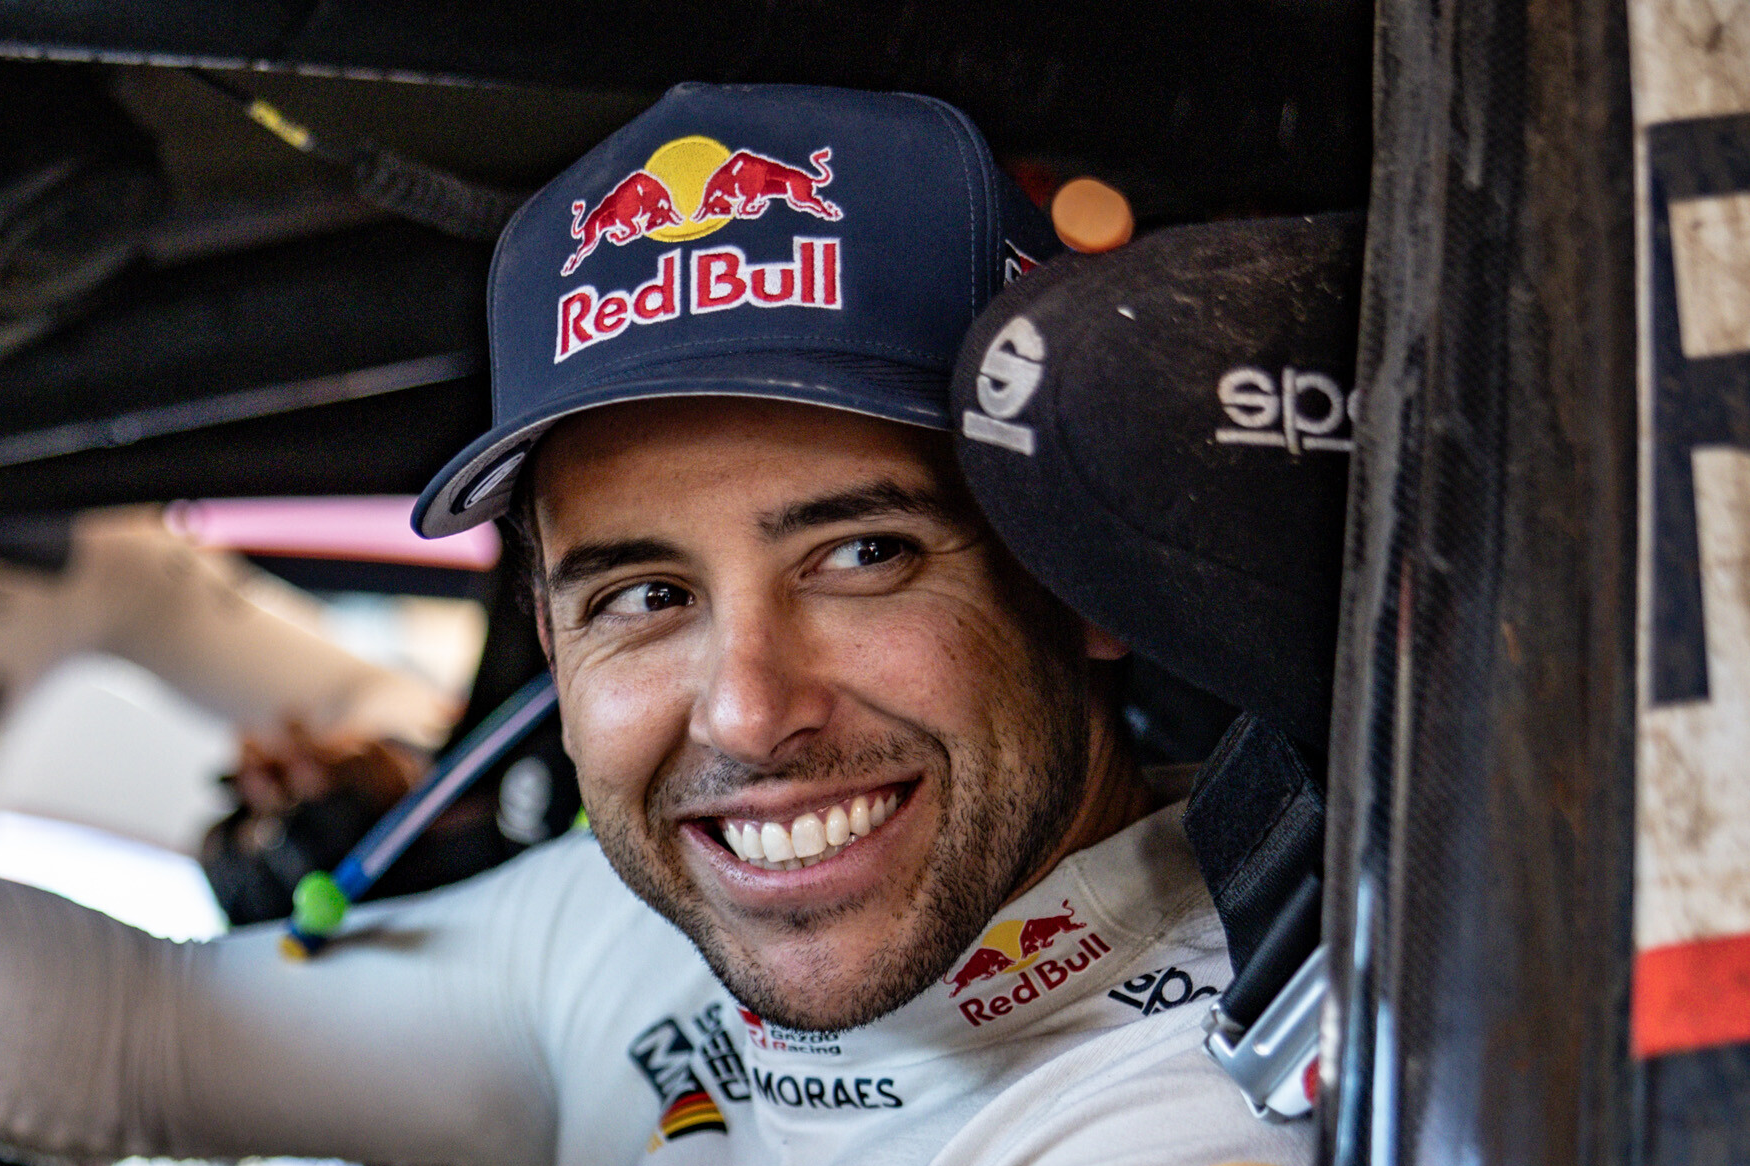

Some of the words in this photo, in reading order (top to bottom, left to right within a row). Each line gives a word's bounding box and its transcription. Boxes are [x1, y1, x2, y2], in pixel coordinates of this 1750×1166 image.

[554, 250, 680, 363] Red
[691, 237, 842, 314] Bull
[958, 972, 1041, 1028] Red
[1033, 933, 1112, 991] Bull
[752, 1066, 904, 1110] MORAES
